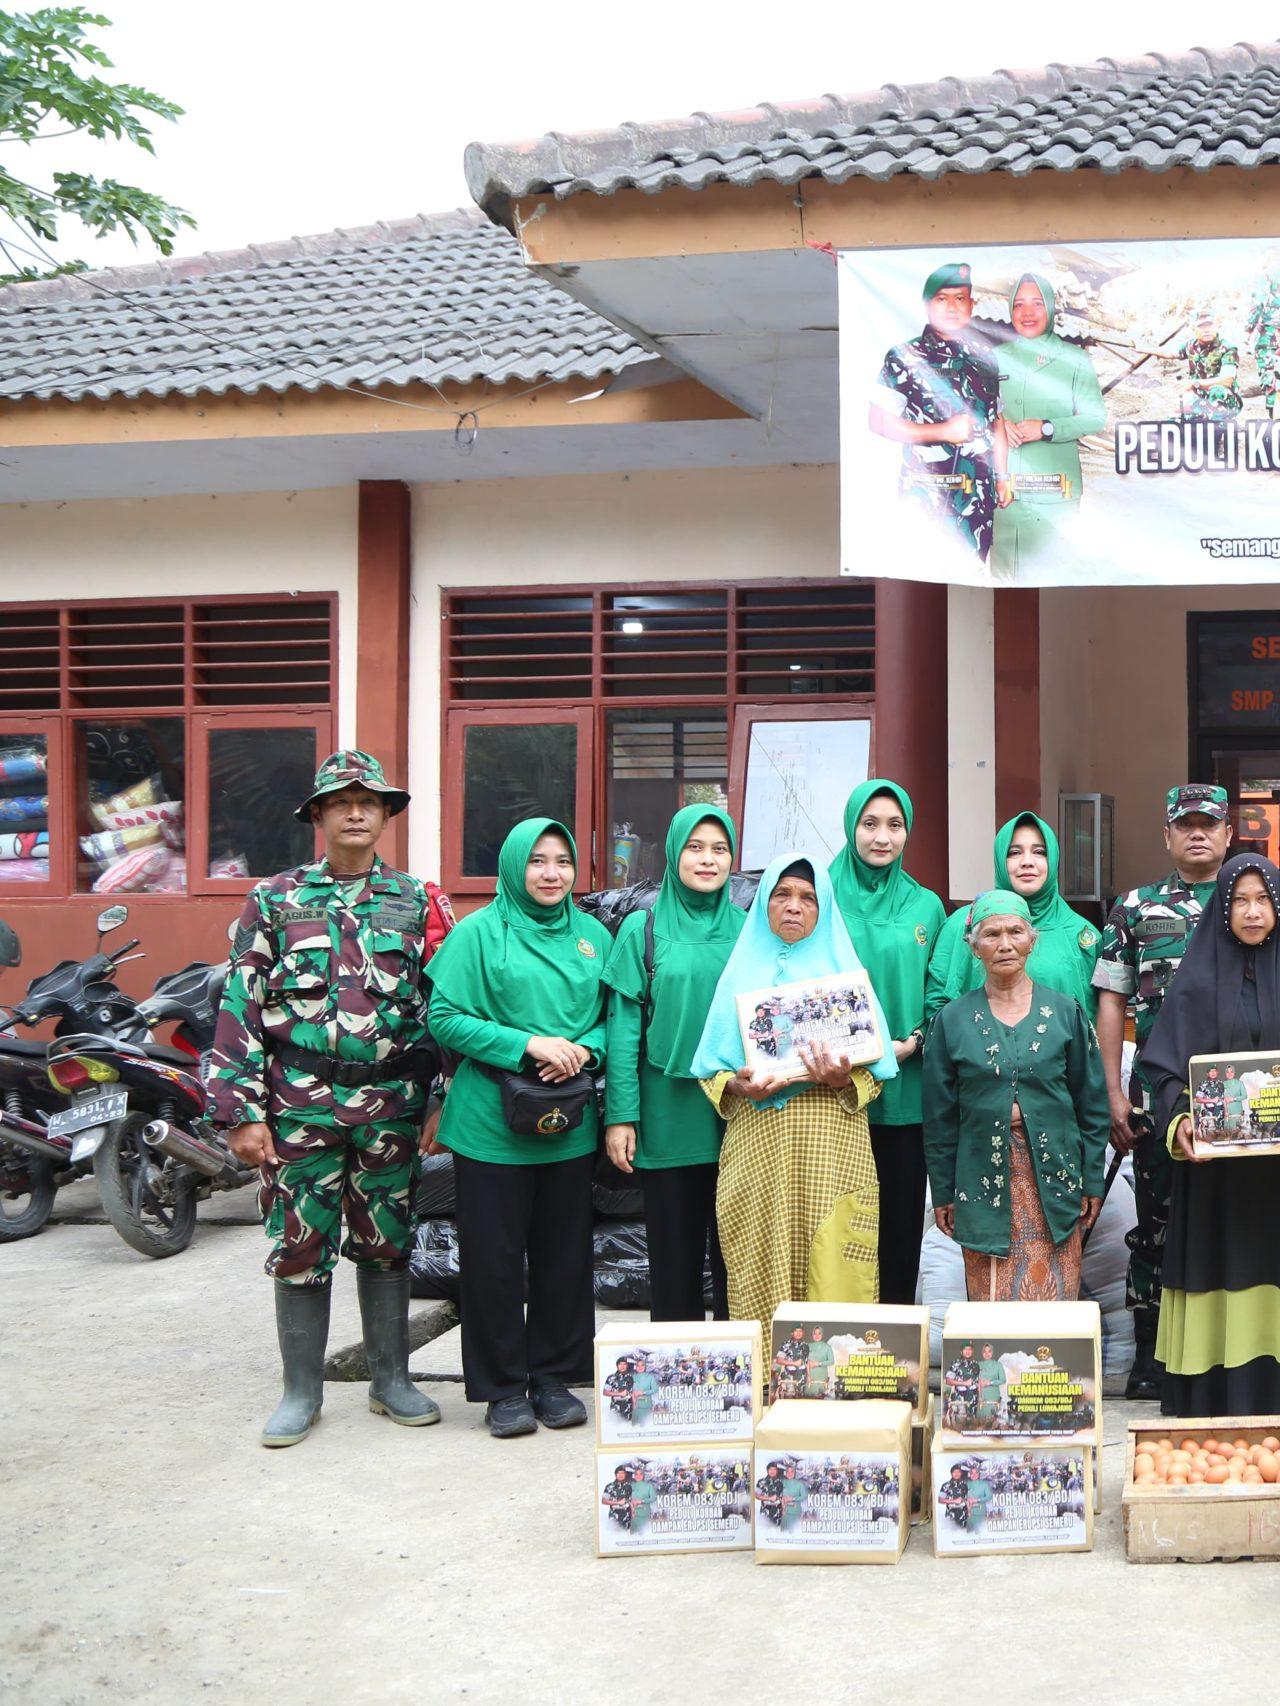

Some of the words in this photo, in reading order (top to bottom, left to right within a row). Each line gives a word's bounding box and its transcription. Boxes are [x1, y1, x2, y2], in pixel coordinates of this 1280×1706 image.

[1115, 420, 1238, 474] PEDULI
[1231, 690, 1273, 711] SMP
[849, 1354, 895, 1366] BANTUAN
[835, 1366, 908, 1377] KEMANUSIAAN
[1021, 1372, 1069, 1384] BANTUAN
[658, 1386, 693, 1400] KOREM
[696, 1383, 740, 1398] 083/BDJ
[1007, 1384, 1083, 1396] KEMANUSIAAN
[657, 1495, 691, 1508] KOREM
[694, 1492, 738, 1506] 083/BDJ
[807, 1494, 842, 1508] KOREM
[844, 1494, 889, 1507] 083/BDJ
[992, 1494, 1027, 1507] KOREM
[1029, 1491, 1073, 1505] 083/BDJ
